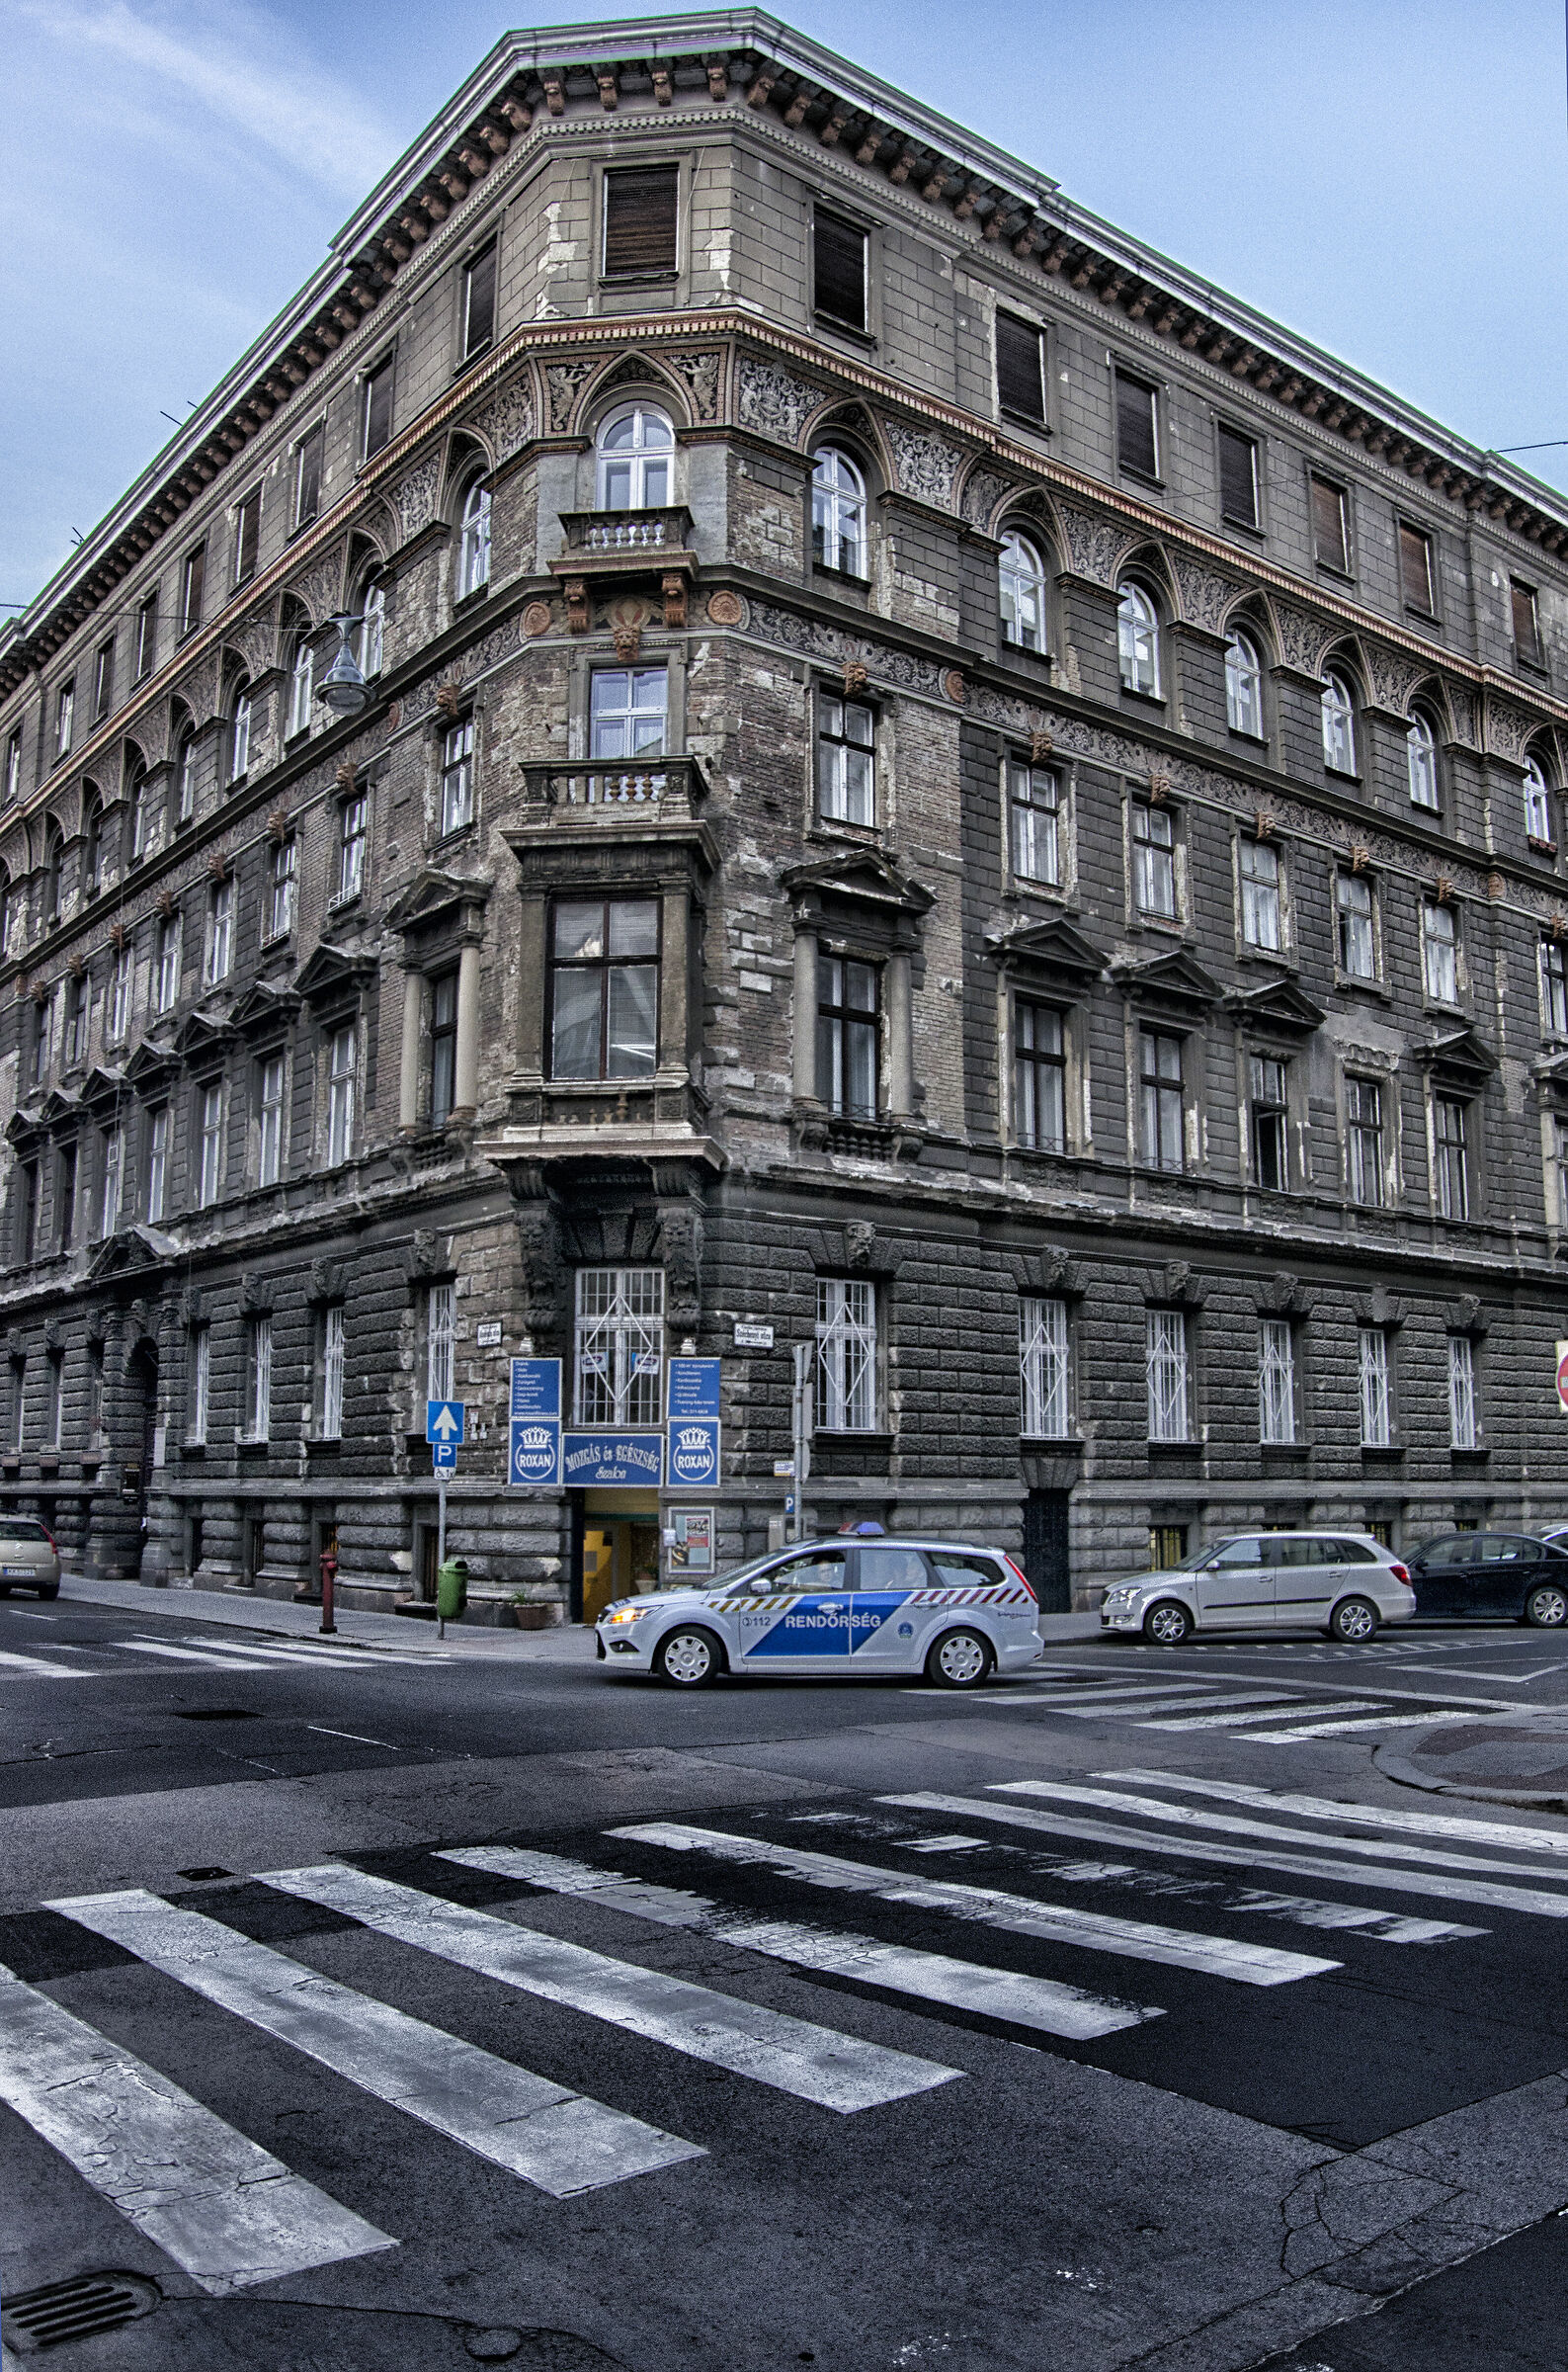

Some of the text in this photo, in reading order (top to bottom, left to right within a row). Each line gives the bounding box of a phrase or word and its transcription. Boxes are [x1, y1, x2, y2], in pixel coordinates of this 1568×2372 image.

[438, 1445, 453, 1463] P
[519, 1454, 551, 1468] ROXAN
[565, 1442, 660, 1473] MOZGÁS és EGÉSZSÉG
[677, 1455, 710, 1469] ROXAN
[785, 1496, 793, 1510] P
[754, 1612, 880, 1628] 112 RENDŐRSÉG
